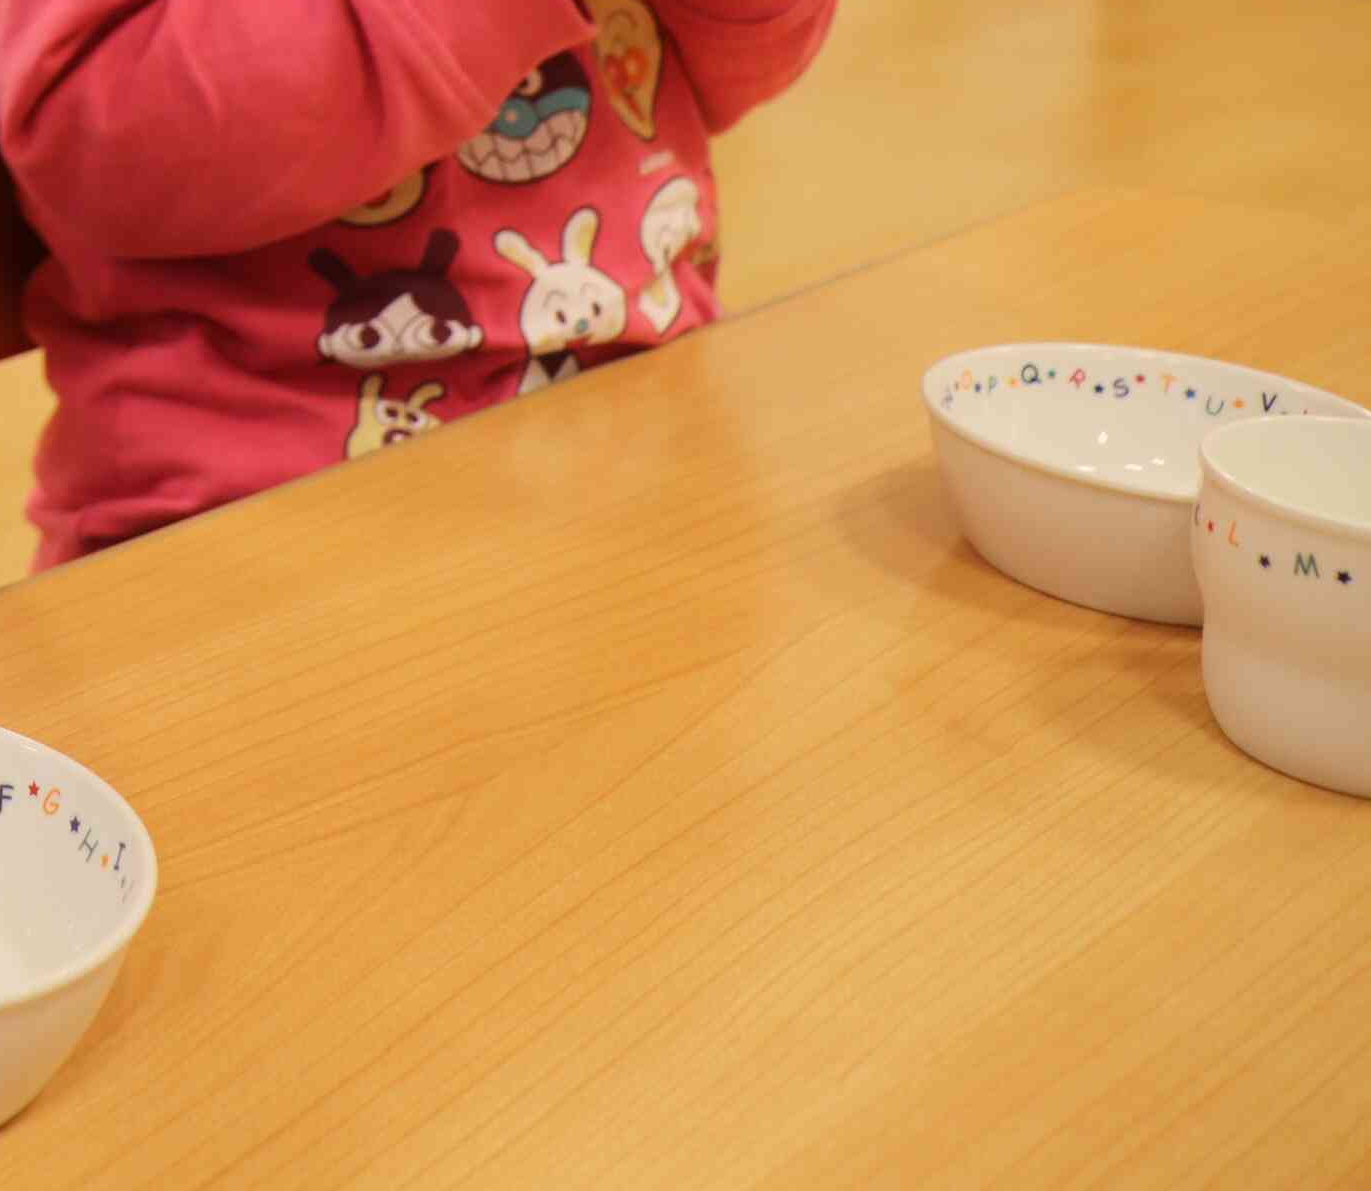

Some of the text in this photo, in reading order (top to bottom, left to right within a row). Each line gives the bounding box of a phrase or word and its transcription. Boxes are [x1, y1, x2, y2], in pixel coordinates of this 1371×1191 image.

[1020, 363, 1042, 385] Q
[1068, 368, 1087, 389] R
[1112, 377, 1131, 398] S
[1159, 374, 1179, 394] T
[1204, 395, 1225, 417] U
[1261, 391, 1278, 413] V
[1227, 519, 1321, 579] L M
[42, 787, 62, 816] G
